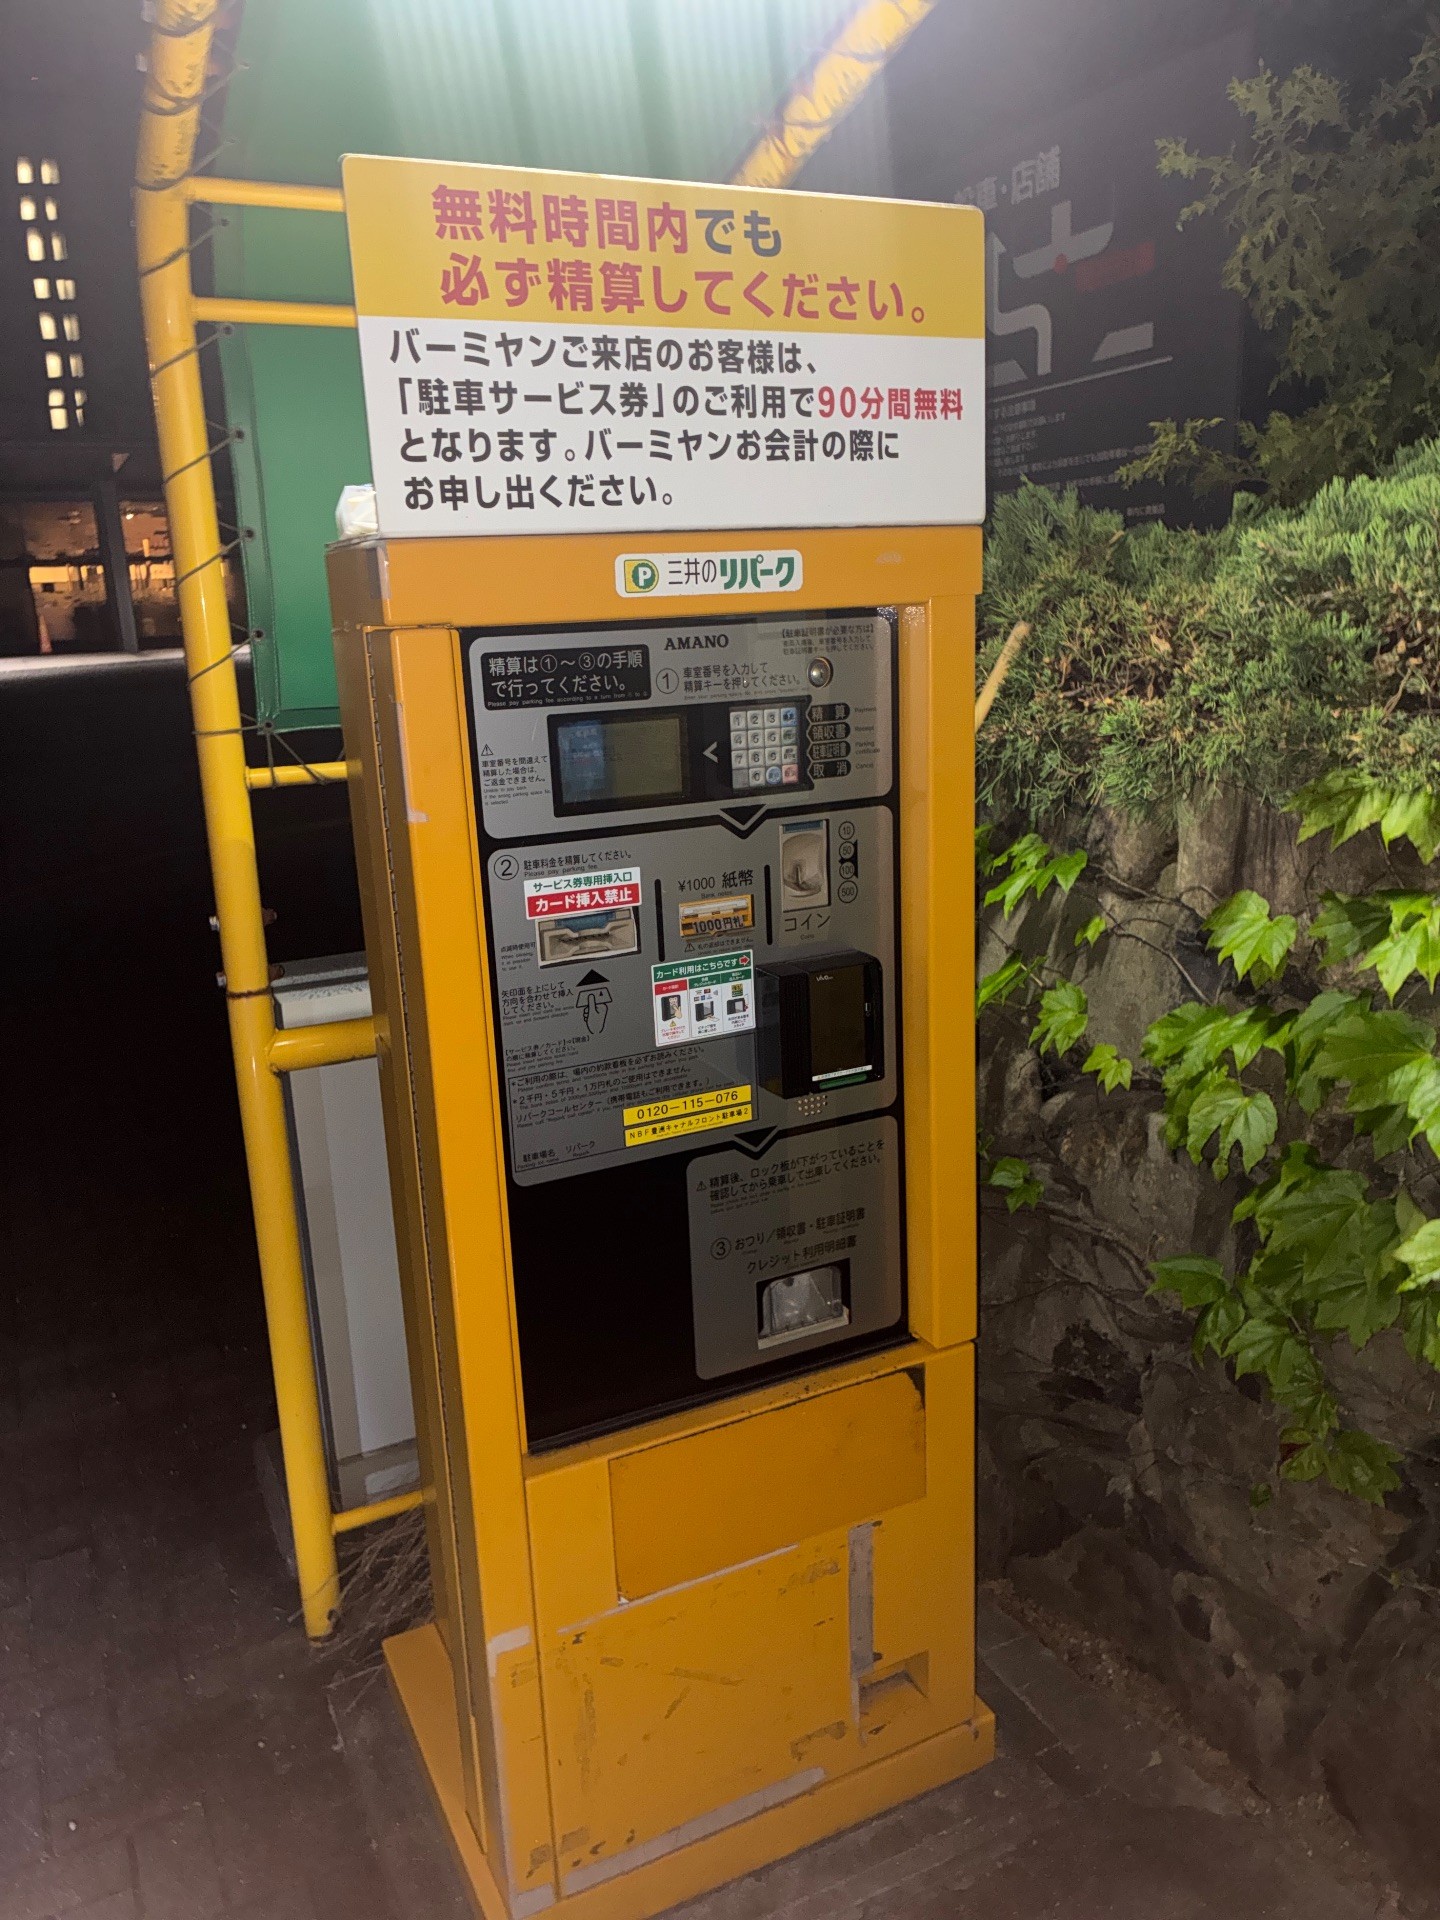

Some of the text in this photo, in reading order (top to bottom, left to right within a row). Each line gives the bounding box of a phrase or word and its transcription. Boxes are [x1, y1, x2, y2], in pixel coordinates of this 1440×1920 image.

[432, 184, 782, 257] 無料時間内でも
[440, 254, 927, 323] 必ず精算してください。
[390, 328, 817, 374] バーミヤンご来店のお客様は、
[398, 376, 964, 421] 「駐車サービス券」のご利用で90分間無料
[399, 428, 901, 462] となります。バーミヤンお会計の際に
[405, 475, 674, 511] お申し出ください。
[667, 555, 795, 591] 三井のリパーク
[664, 634, 729, 650] AMANO
[683, 662, 768, 678] 車室番号を入力して
[491, 674, 626, 698] で行ってください。
[523, 850, 632, 871] 駐車料金を精算してください。
[524, 869, 545, 878] Please
[533, 871, 632, 893] サービス券専用挿入口
[721, 869, 755, 888] 紙幣
[536, 887, 633, 913] カード挿入禁止
[784, 913, 831, 932] コイン
[656, 958, 739, 979] カード利用はこちらです
[501, 981, 565, 998] 矢印面を上にして
[503, 1002, 555, 1016] してください。
[637, 1090, 739, 1119] 0120-115-076
